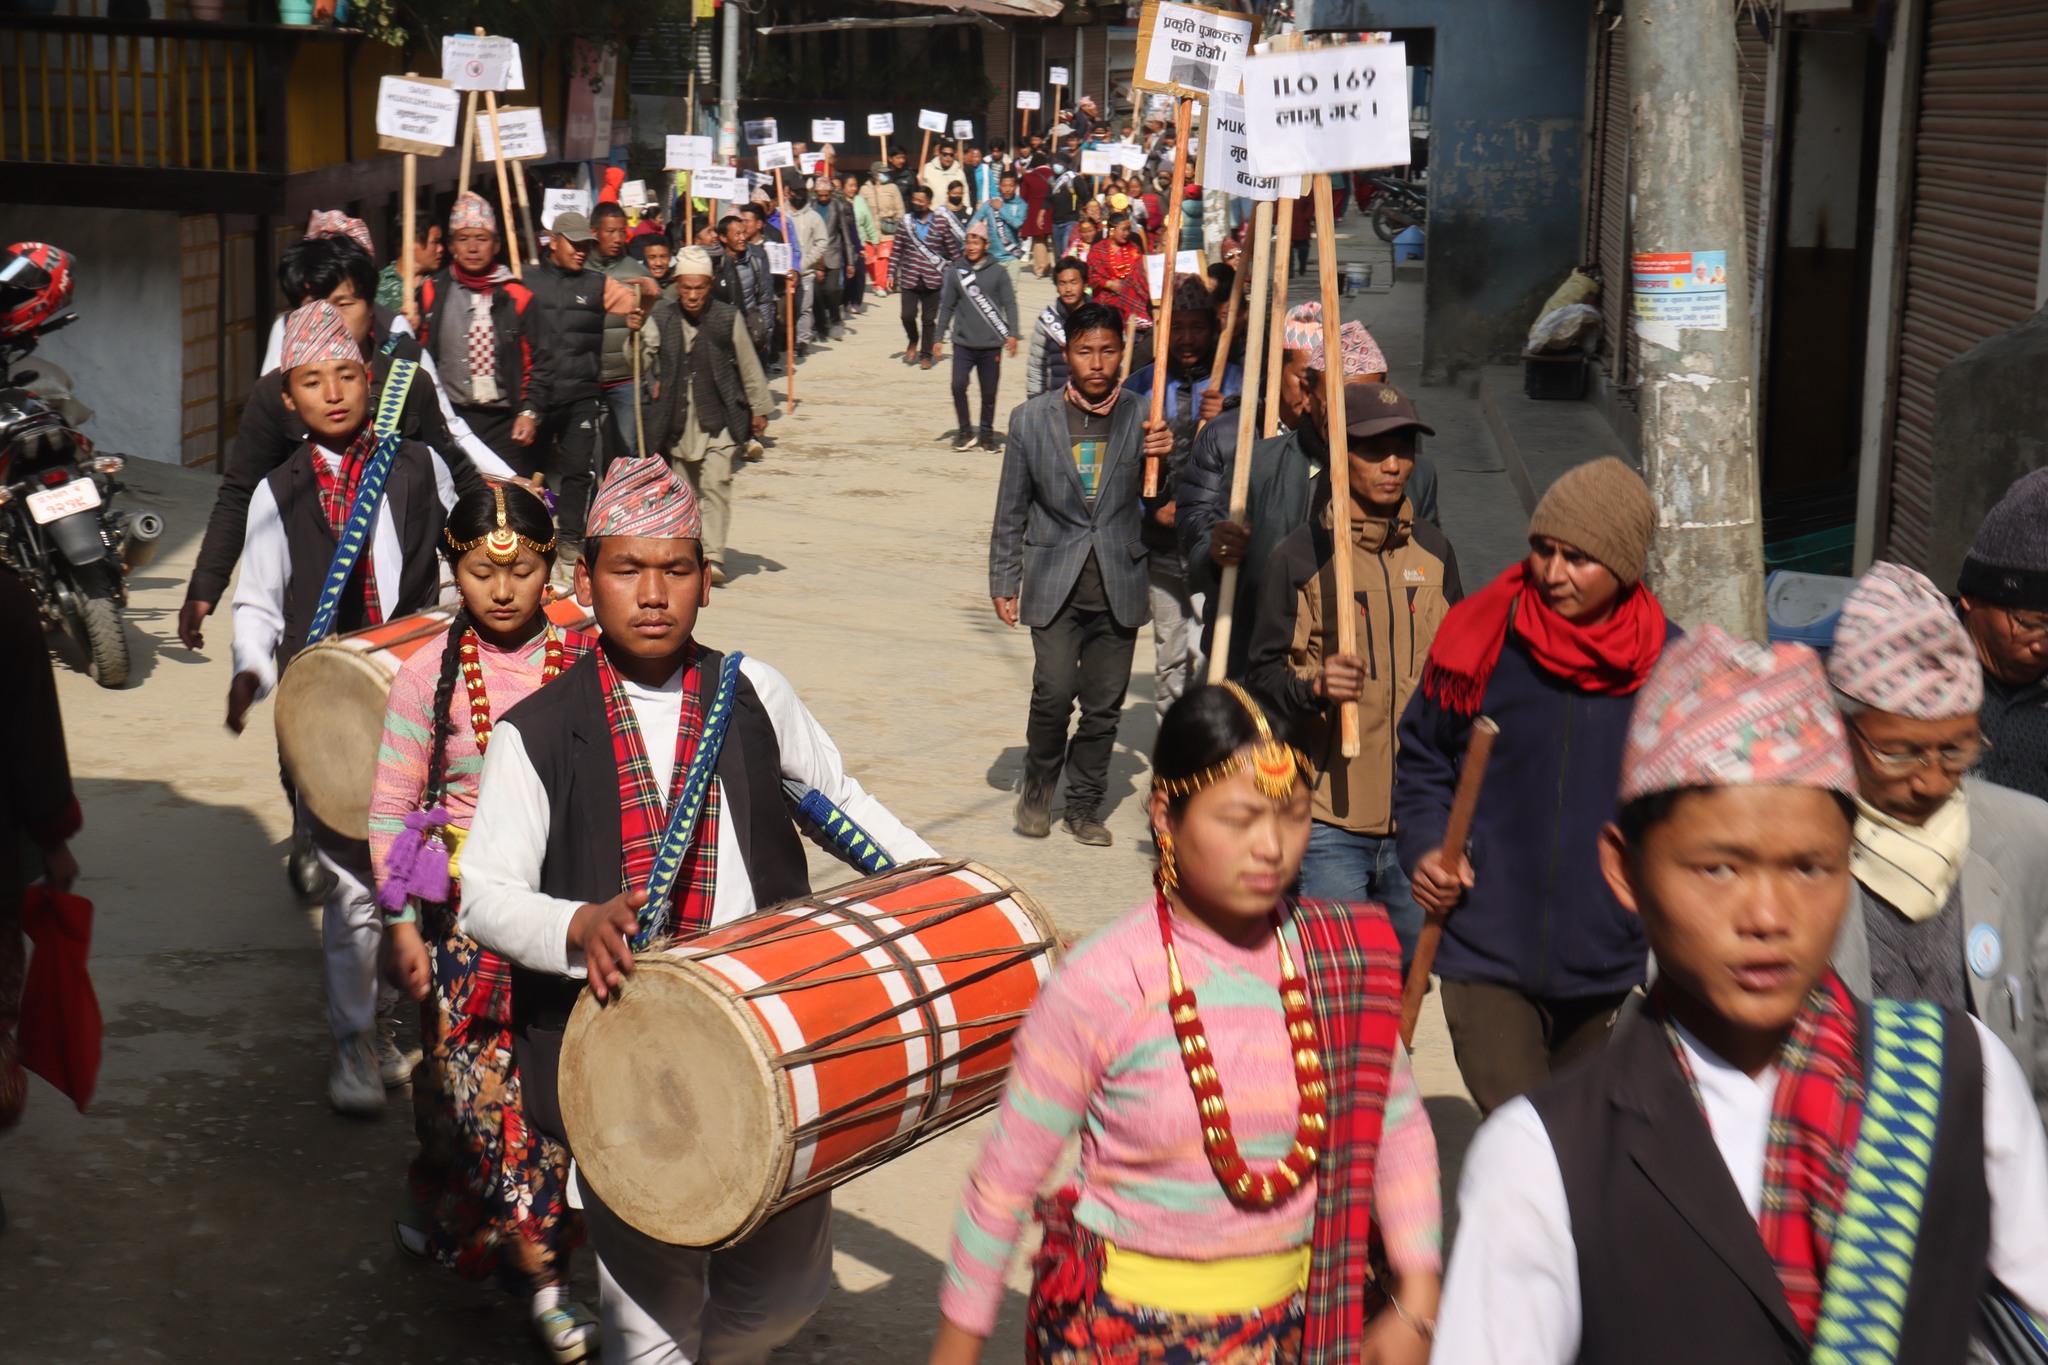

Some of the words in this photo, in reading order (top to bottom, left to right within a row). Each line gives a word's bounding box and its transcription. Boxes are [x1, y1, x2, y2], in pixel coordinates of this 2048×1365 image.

[1163, 16, 1197, 34] प्रकृति
[1170, 38, 1195, 54] एक
[1273, 73, 1319, 98] ILO
[1332, 65, 1377, 93] 169
